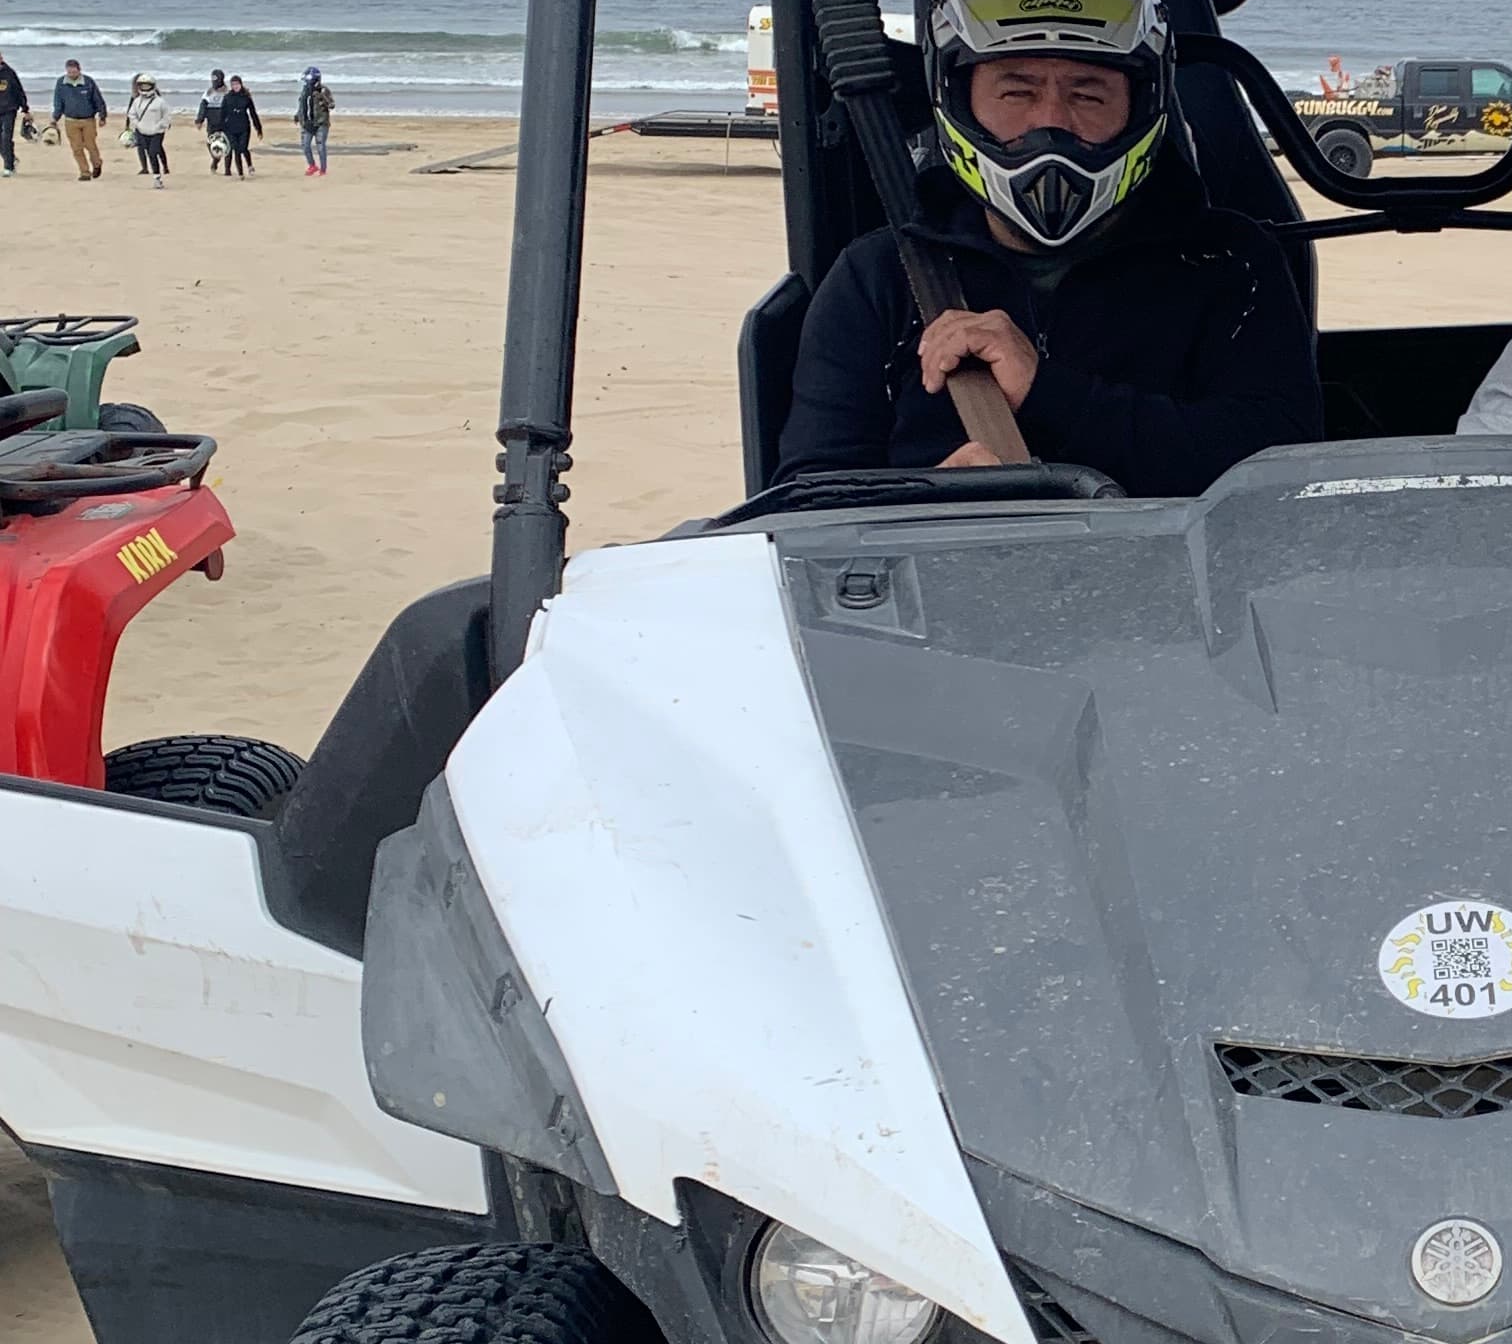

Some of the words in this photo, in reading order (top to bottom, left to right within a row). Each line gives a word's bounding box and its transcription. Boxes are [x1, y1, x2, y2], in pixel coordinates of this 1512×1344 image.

[116, 527, 178, 585] KIRK
[1426, 910, 1495, 935] UW
[1429, 982, 1496, 1007] 401
